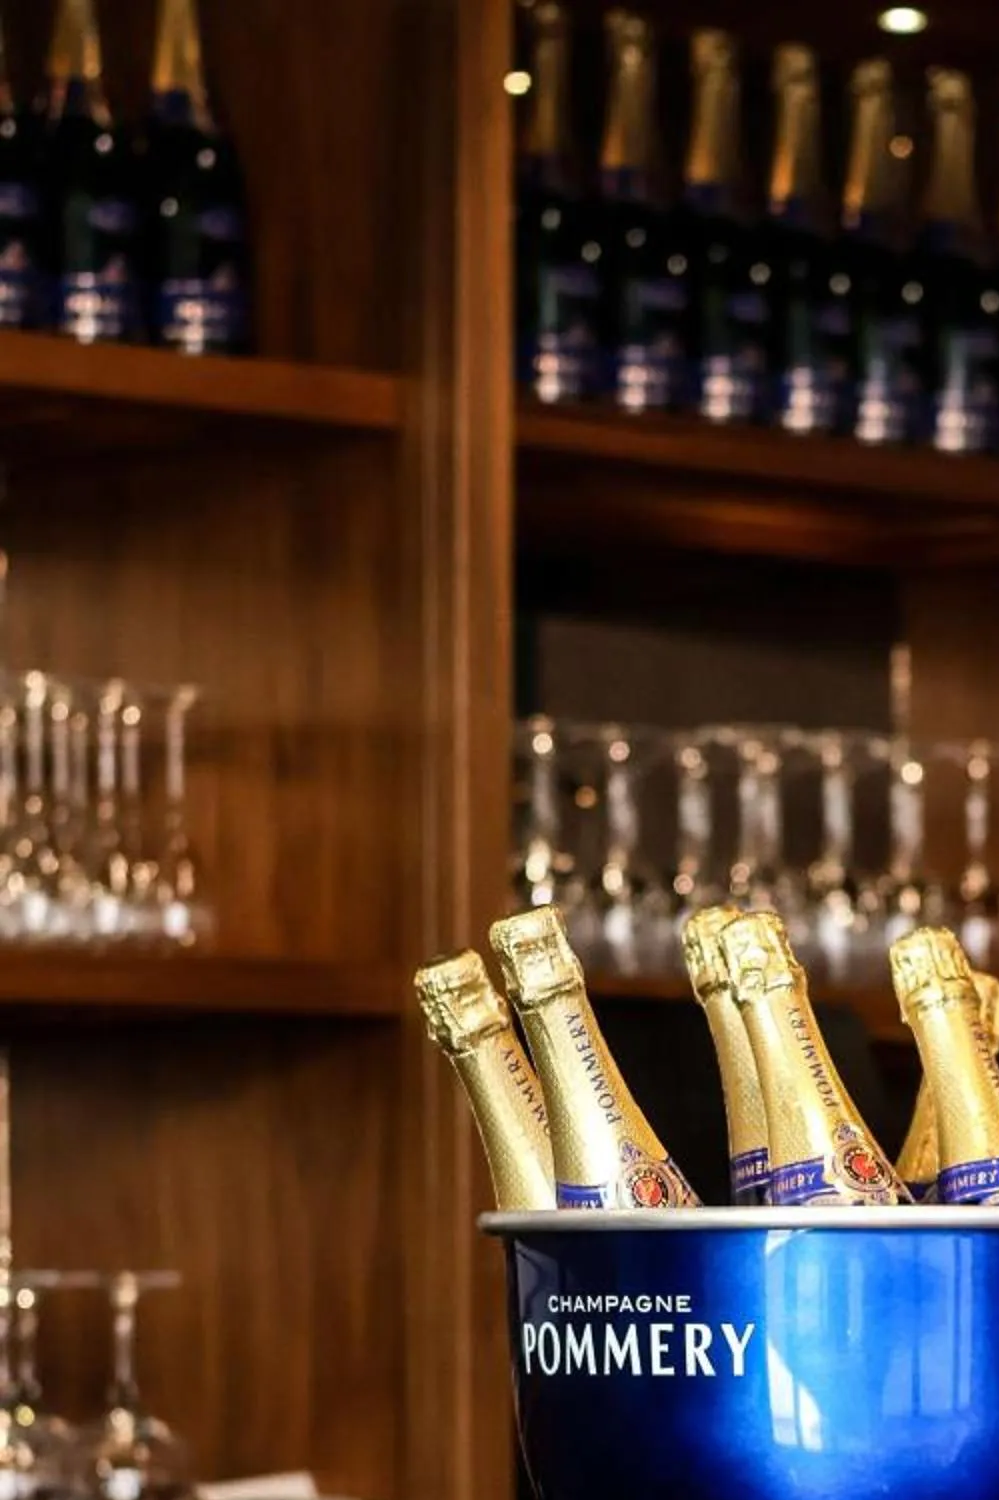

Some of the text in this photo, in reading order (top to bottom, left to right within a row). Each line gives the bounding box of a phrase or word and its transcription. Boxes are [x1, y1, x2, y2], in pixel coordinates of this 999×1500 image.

[565, 1012, 622, 1124] POMMERY
[786, 1007, 840, 1107] POMMERY
[547, 1295, 692, 1313] CHAMPAGNE
[523, 1322, 755, 1377] POMMERY
